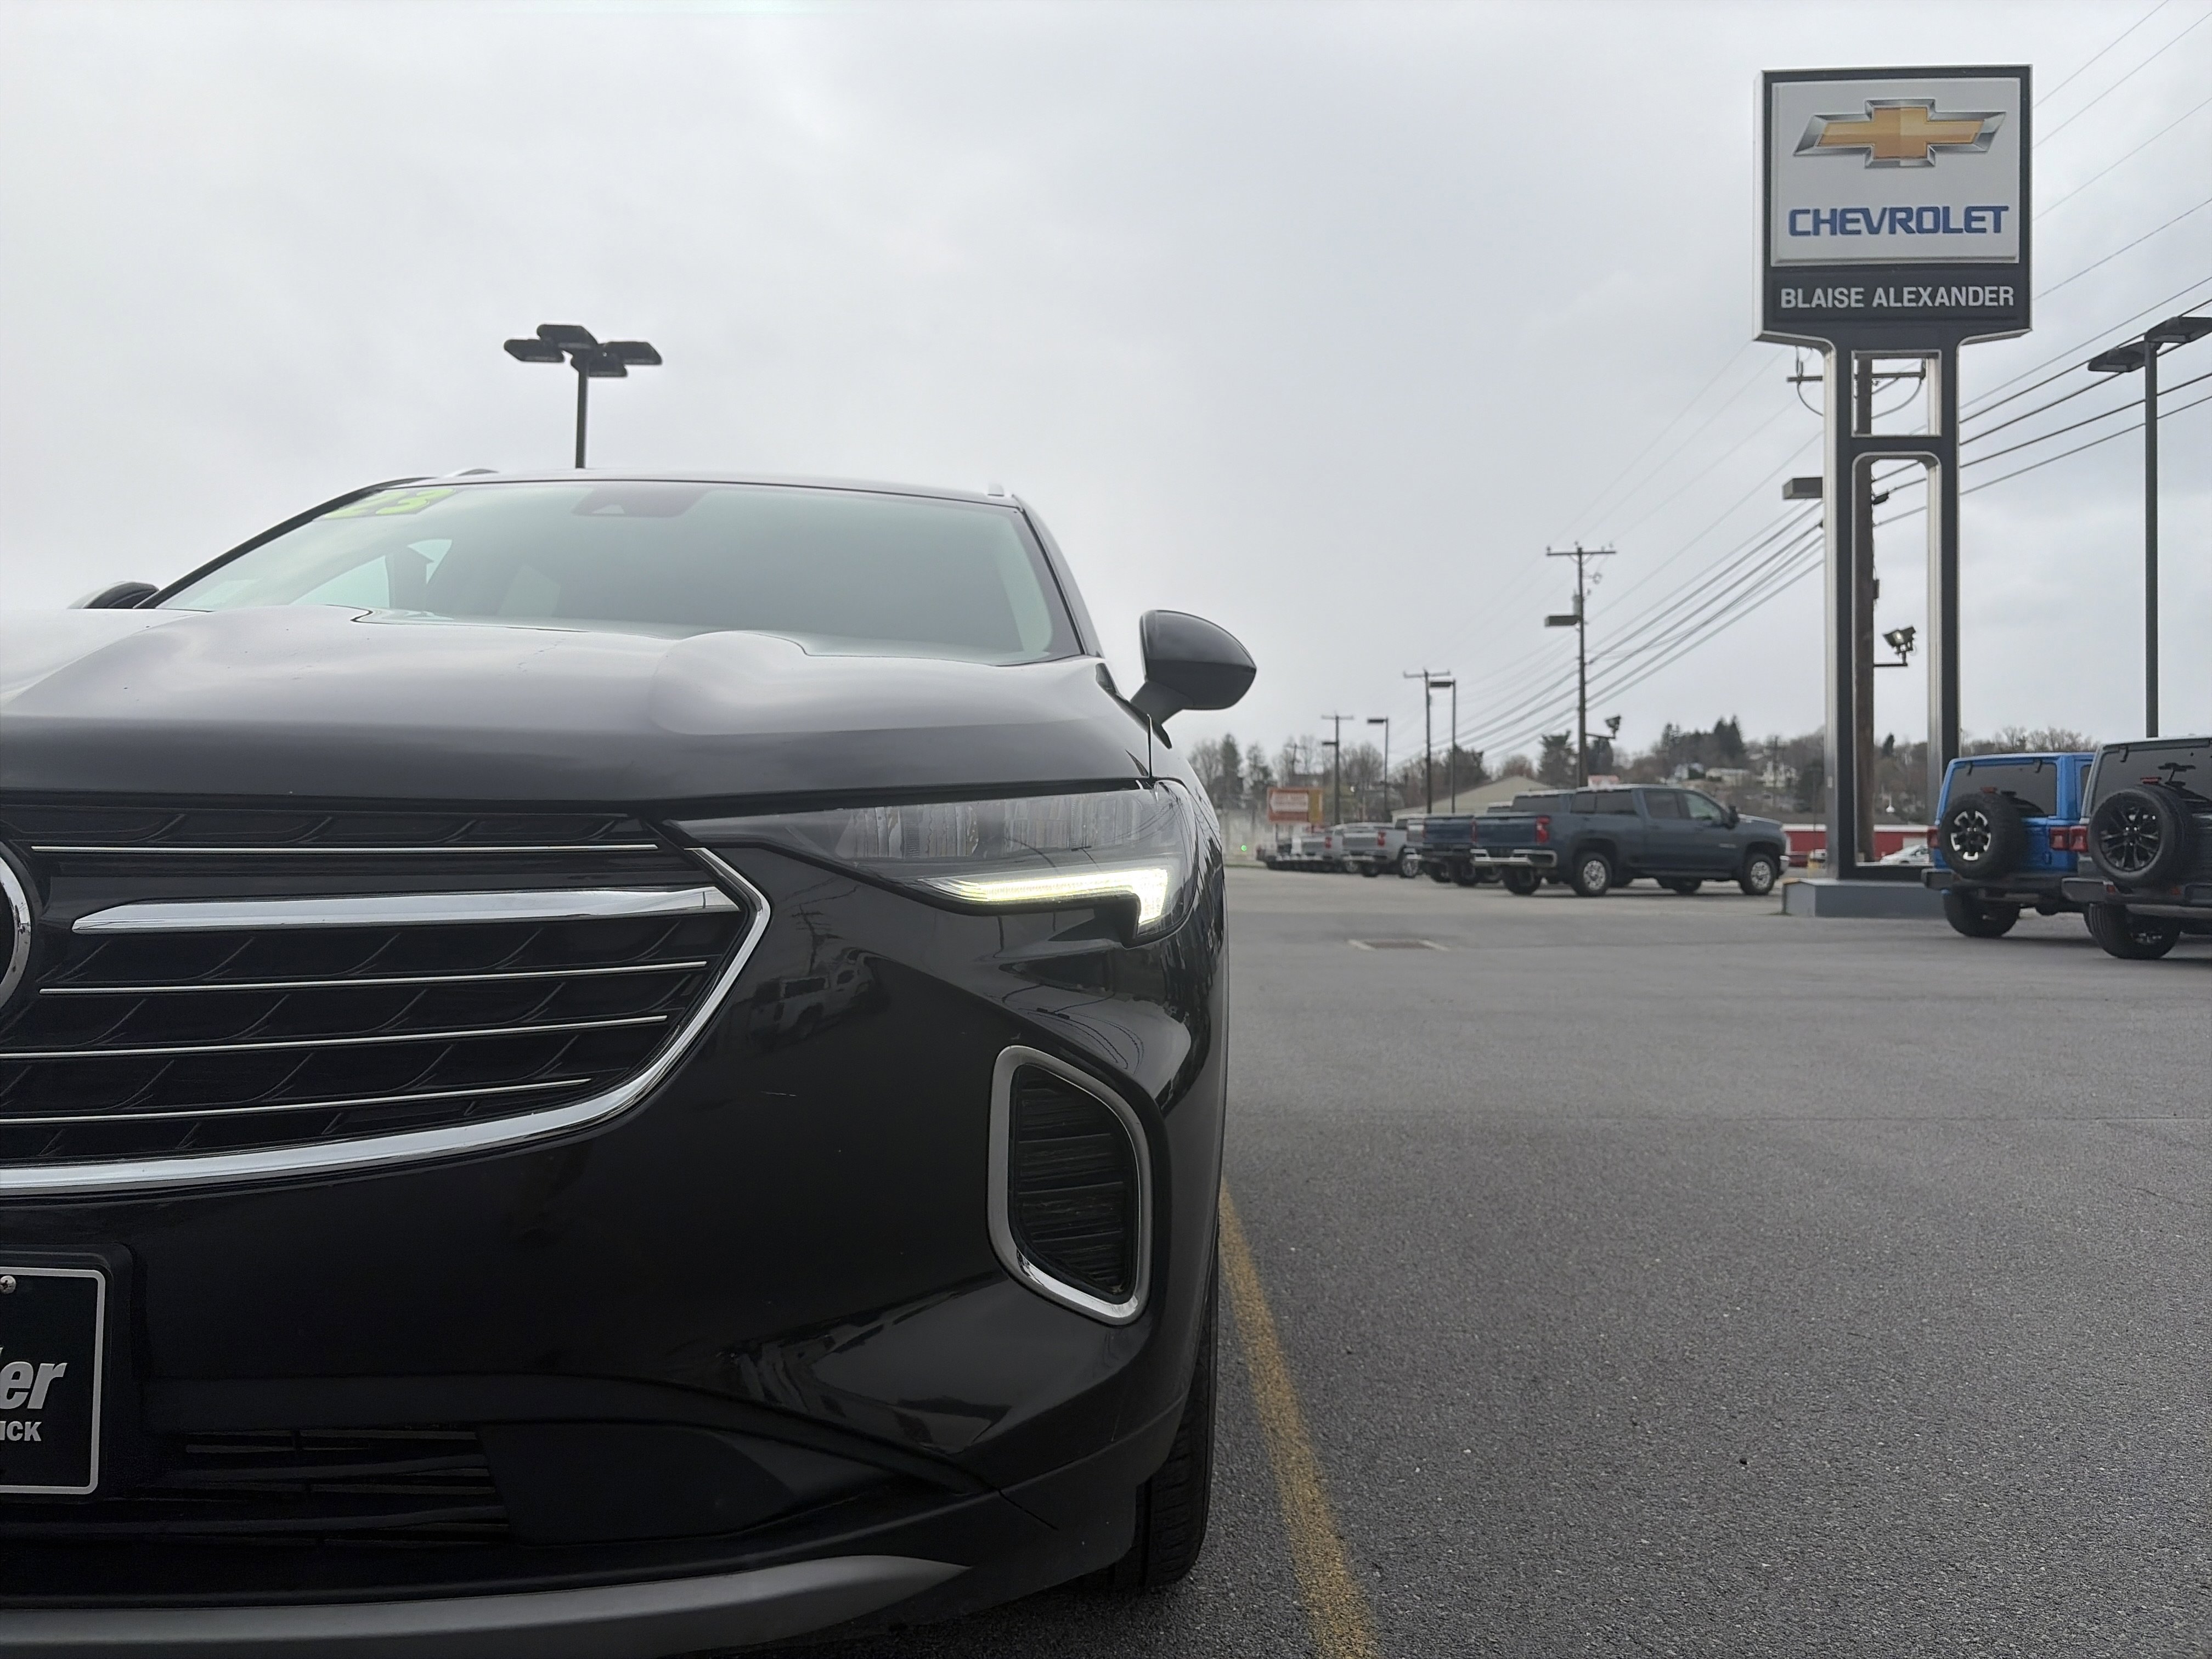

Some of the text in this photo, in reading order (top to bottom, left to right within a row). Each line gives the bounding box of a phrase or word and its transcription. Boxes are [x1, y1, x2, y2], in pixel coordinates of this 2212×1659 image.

[1788, 206, 2009, 236] CHEVROLET
[1781, 286, 2014, 308] BLAISE ALEXANDER
[0, 1347, 67, 1409] er
